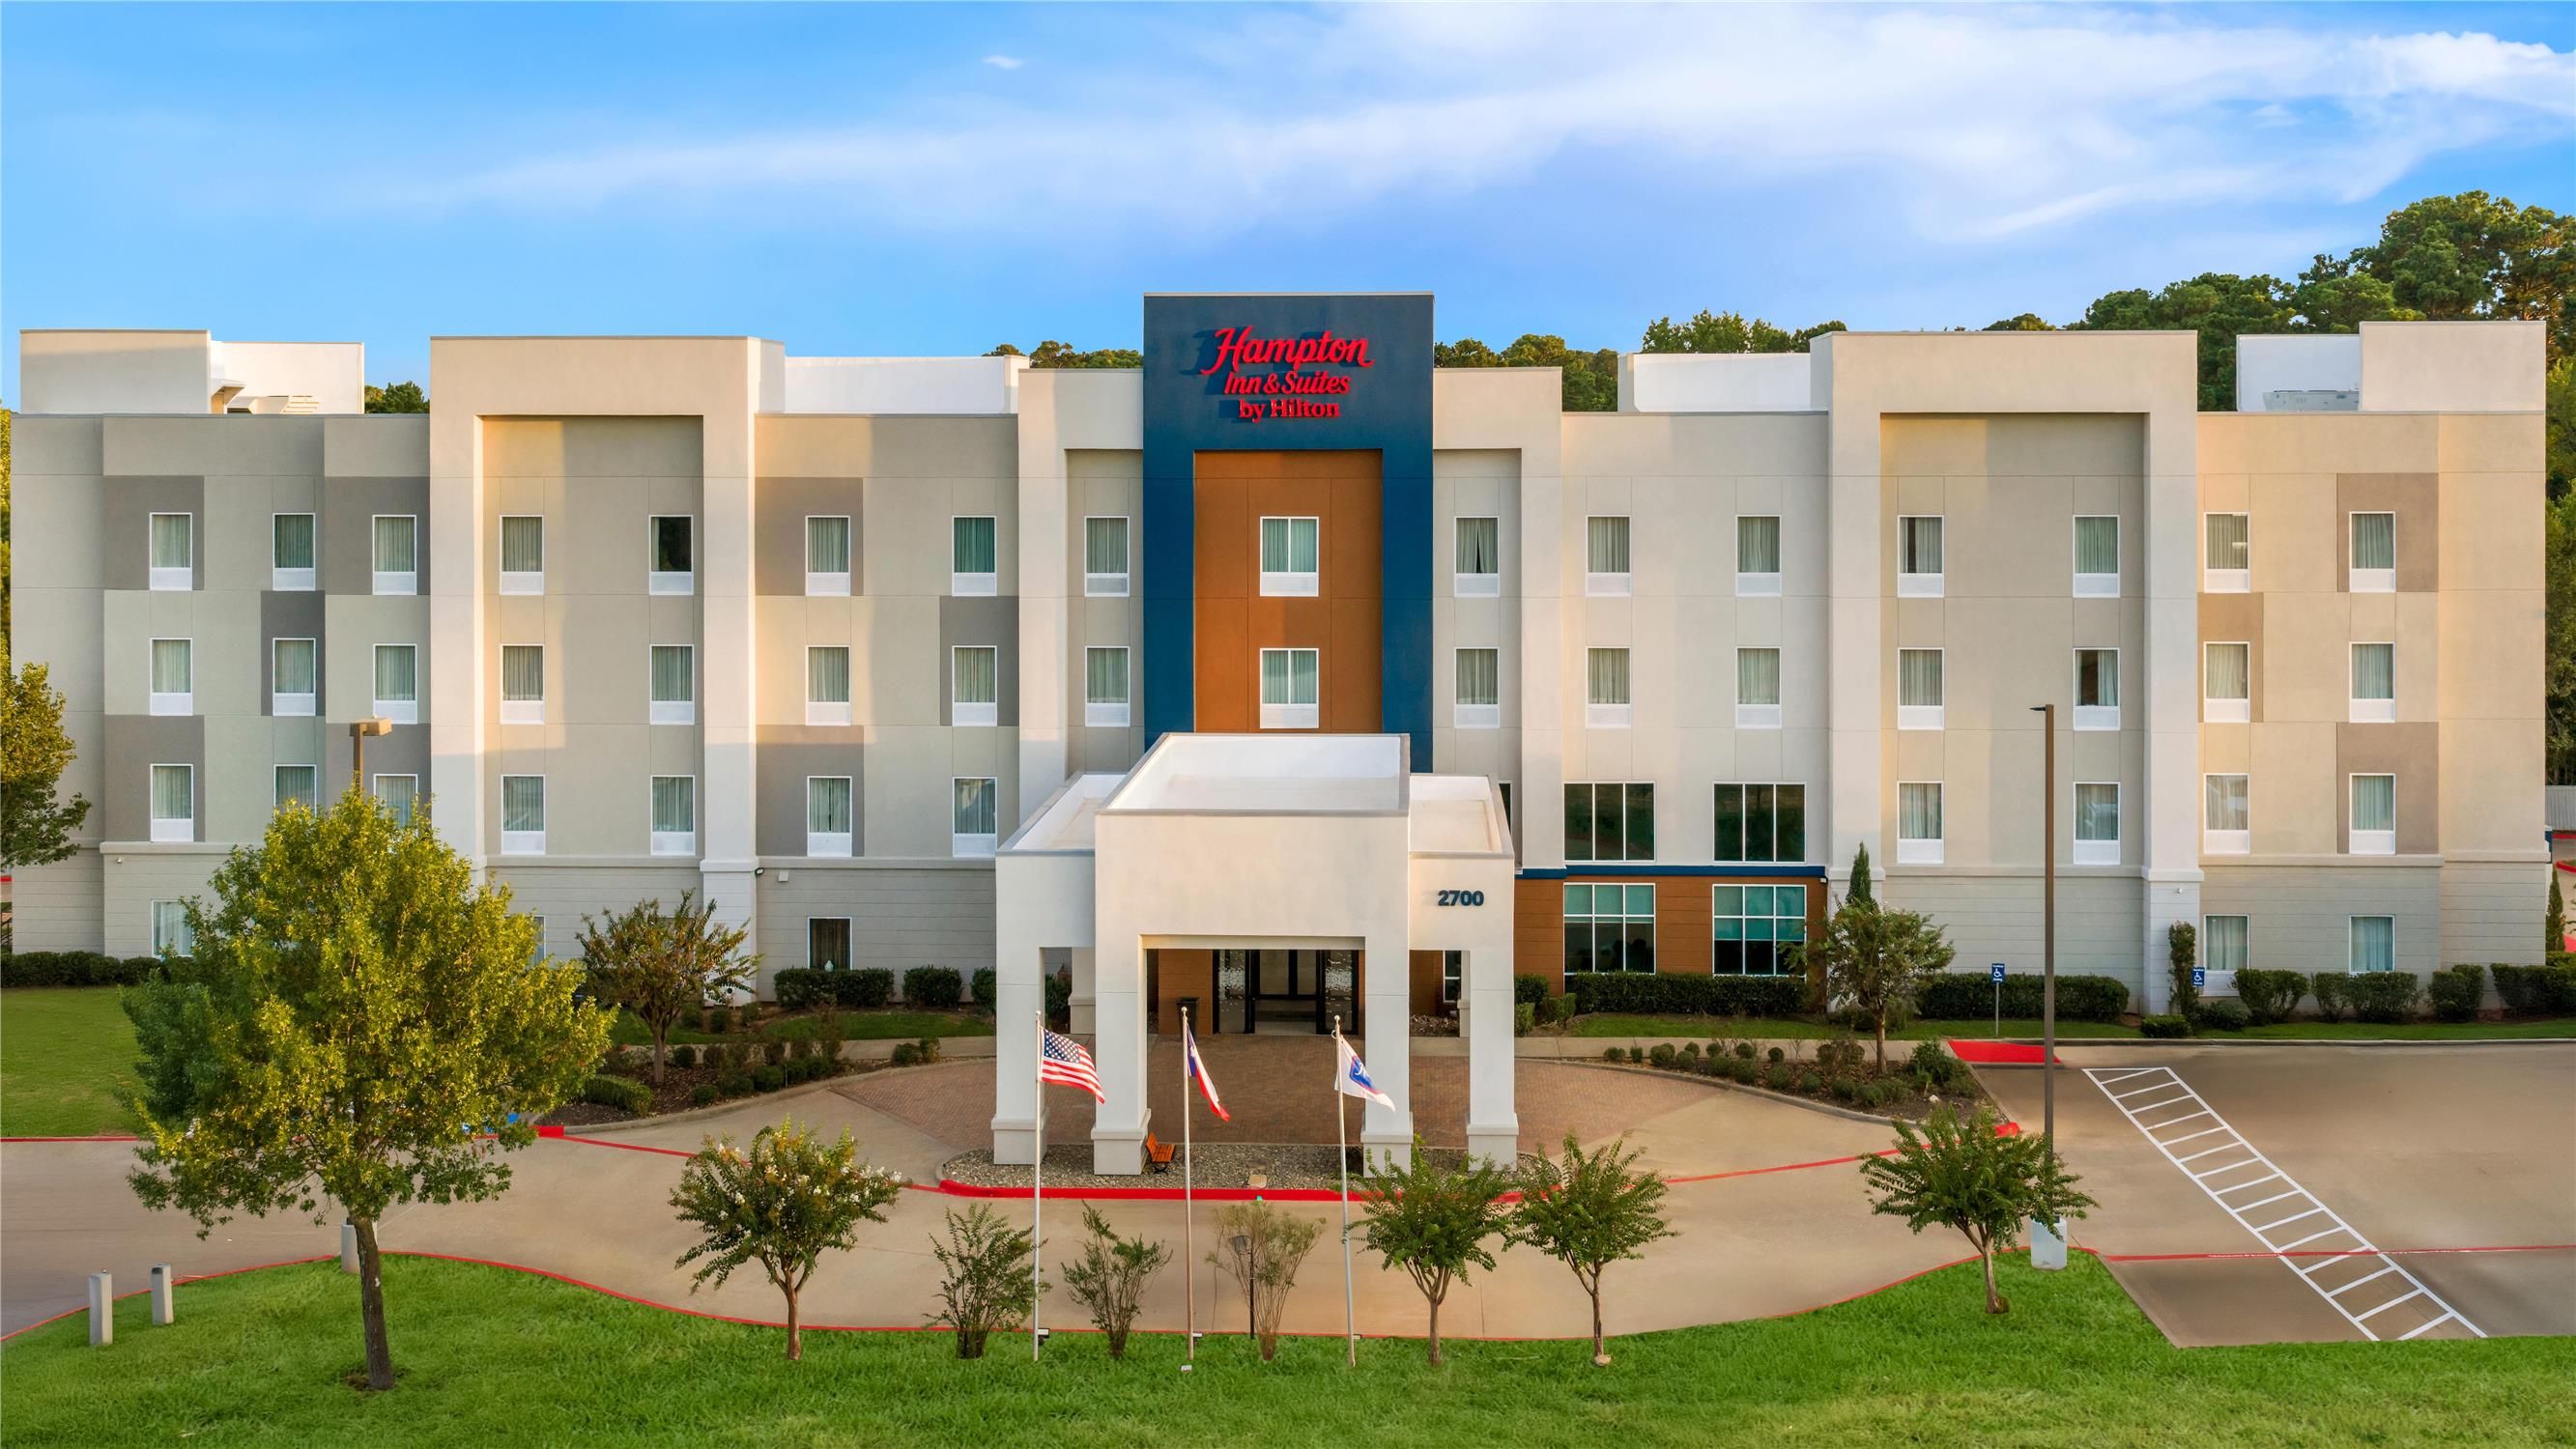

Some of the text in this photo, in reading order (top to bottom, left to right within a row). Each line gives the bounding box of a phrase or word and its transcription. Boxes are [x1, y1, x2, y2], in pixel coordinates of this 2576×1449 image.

[1200, 325, 1376, 375] Hampton
[1224, 371, 1351, 394] Inn & Suites
[1239, 397, 1341, 423] by Hilton
[1438, 890, 1485, 906] 2700
